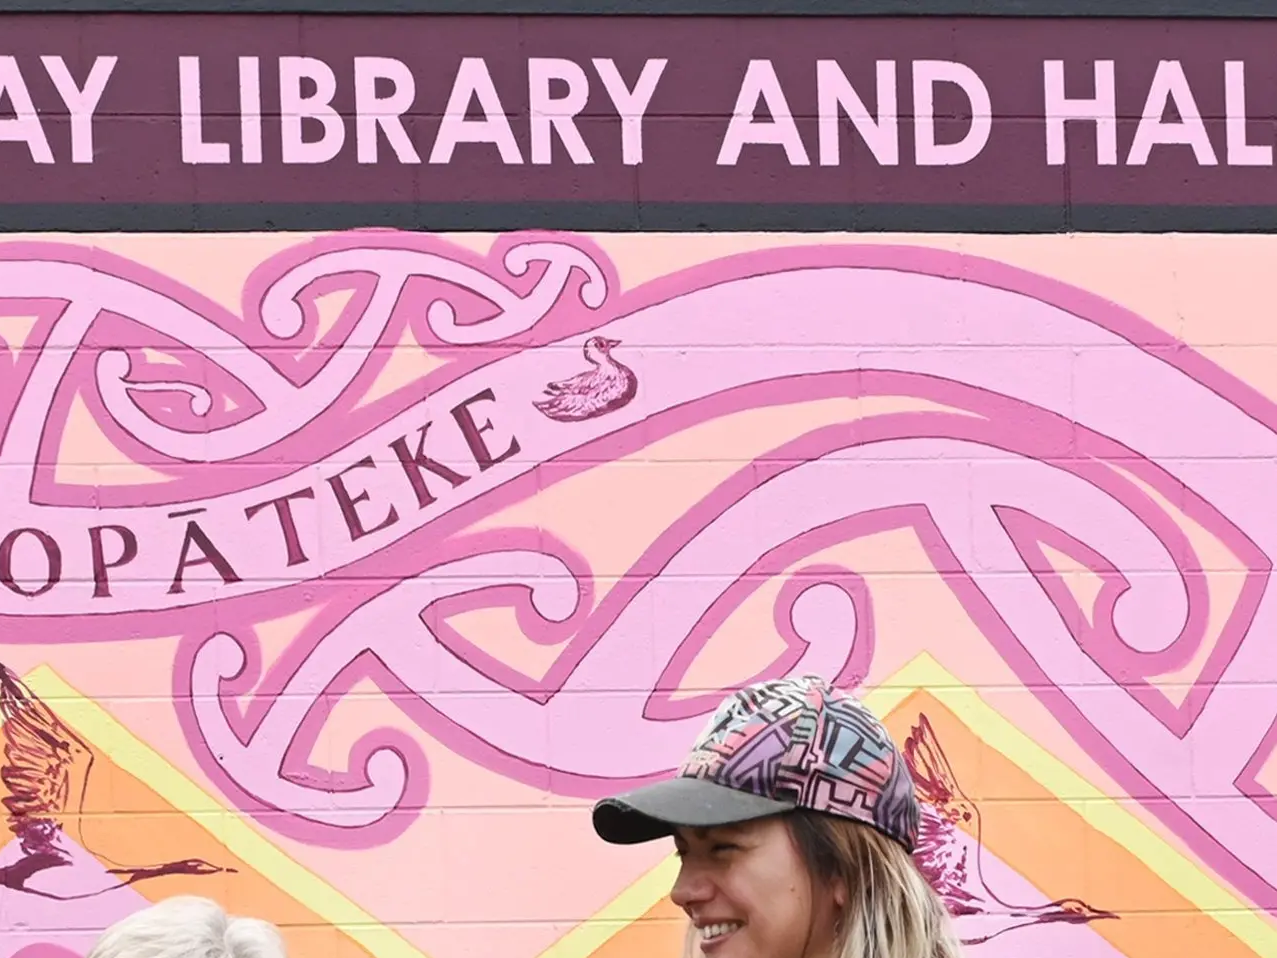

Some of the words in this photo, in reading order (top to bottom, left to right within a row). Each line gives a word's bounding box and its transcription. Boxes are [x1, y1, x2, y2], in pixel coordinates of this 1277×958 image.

[178, 56, 668, 166] LIBRARY
[716, 59, 992, 166] AND
[1043, 59, 1273, 166] HAL
